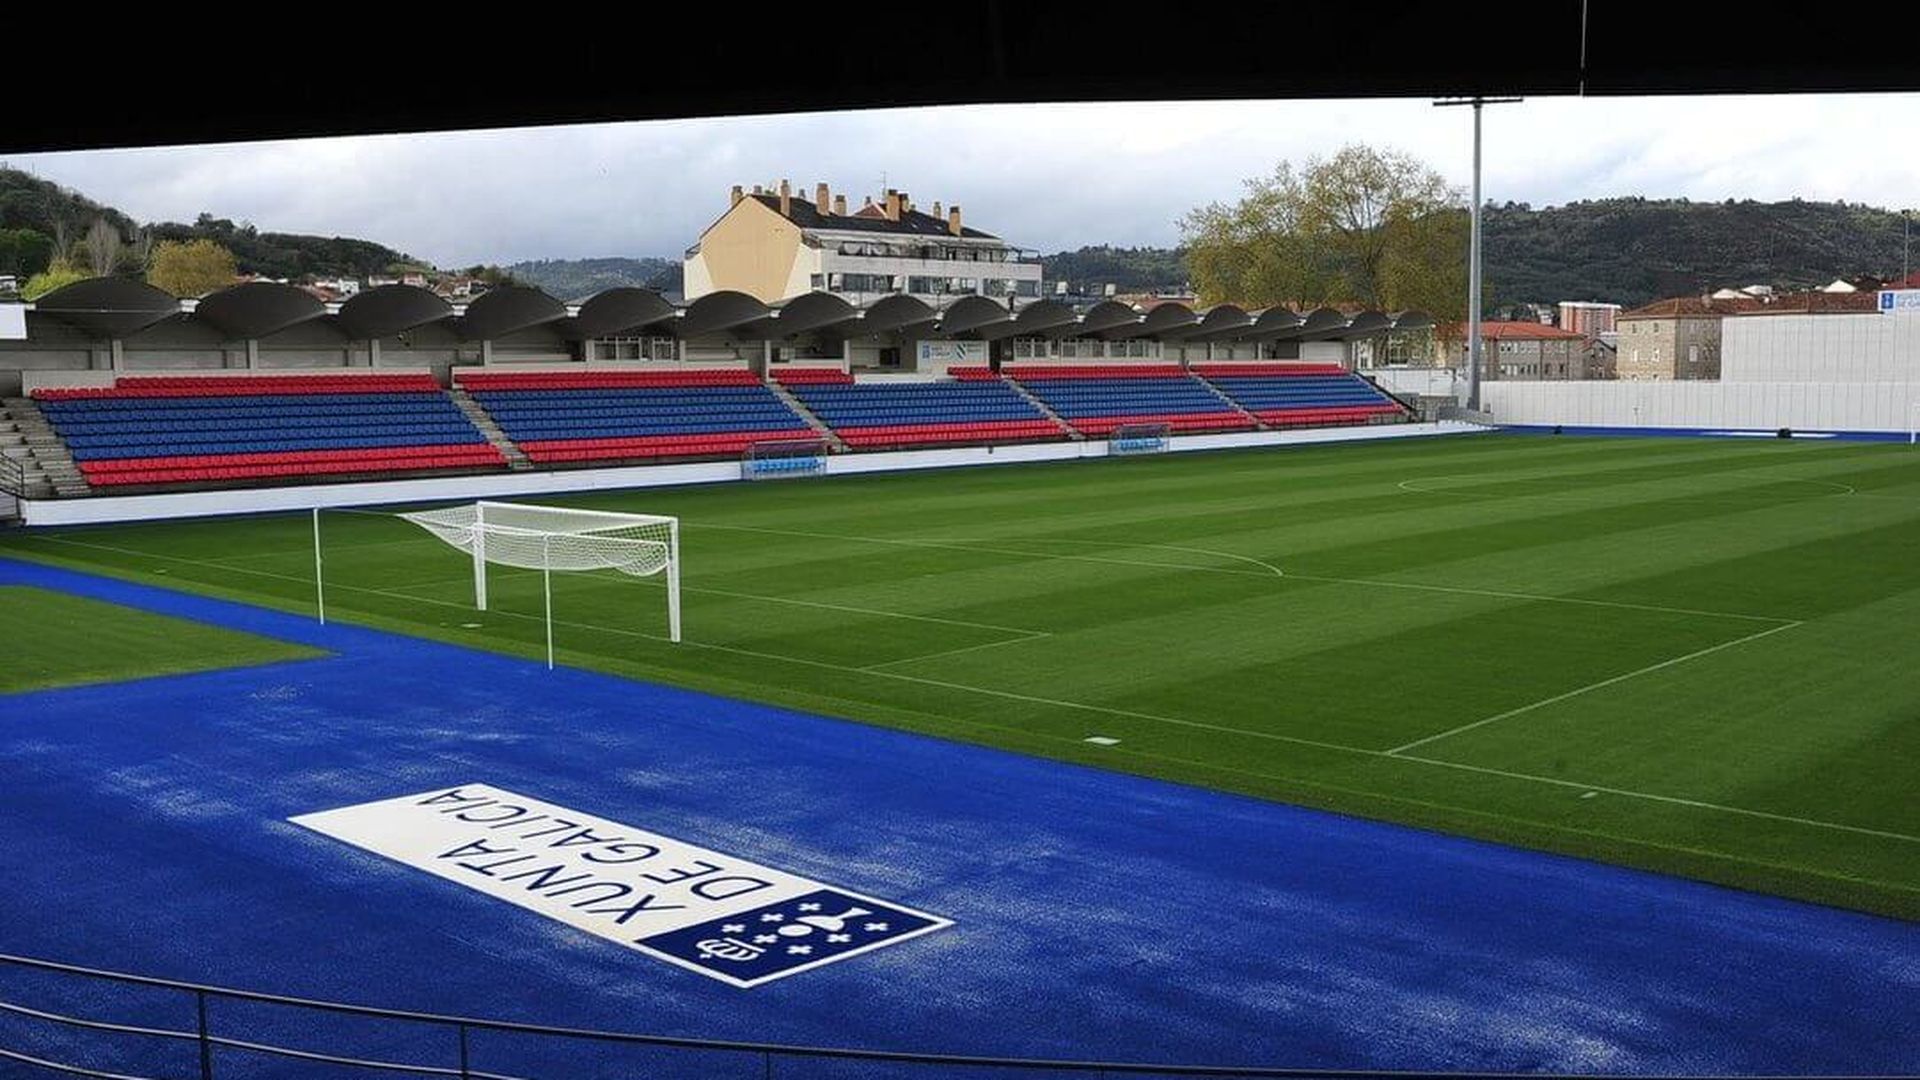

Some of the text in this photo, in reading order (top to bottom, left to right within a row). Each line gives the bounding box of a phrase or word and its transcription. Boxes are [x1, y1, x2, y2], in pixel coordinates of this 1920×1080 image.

[417, 788, 774, 902] DE GALICIA
[437, 838, 686, 925] XUNTA
